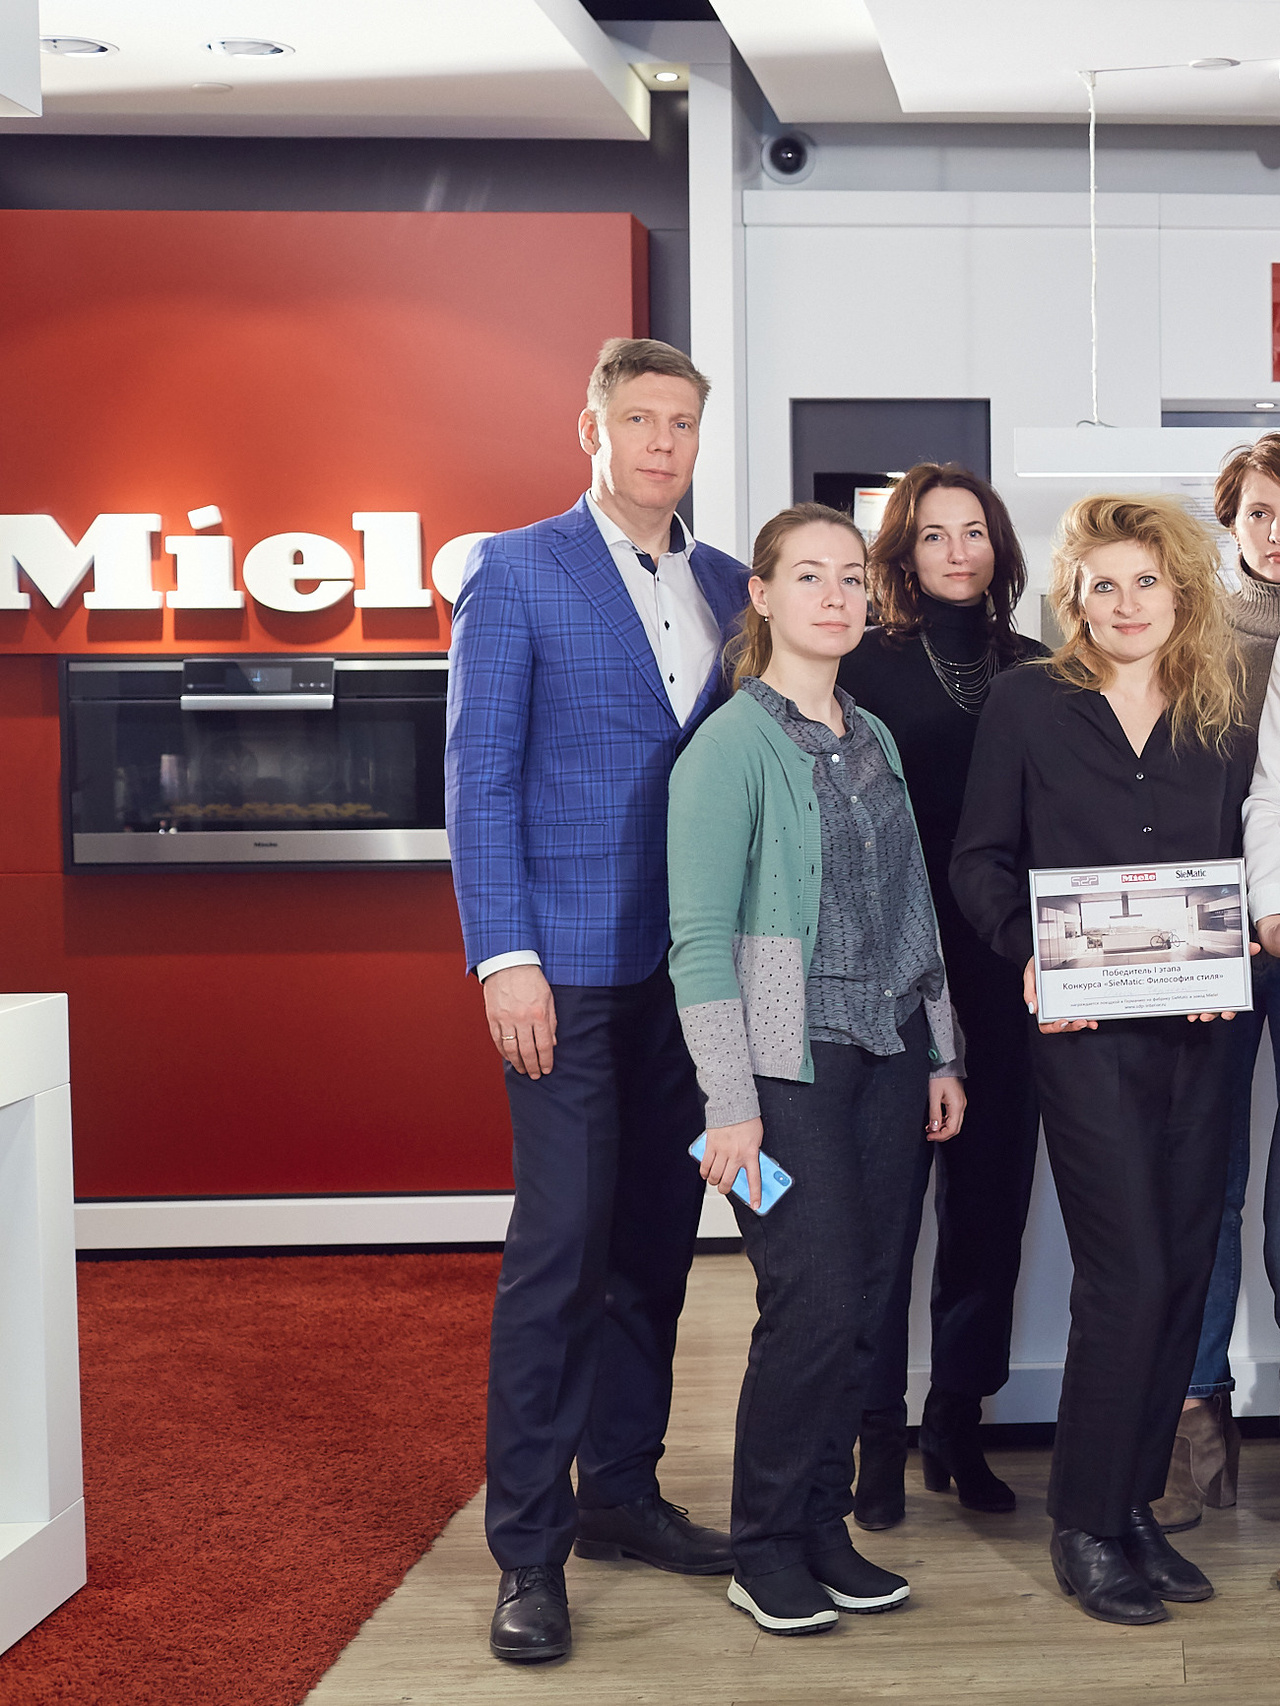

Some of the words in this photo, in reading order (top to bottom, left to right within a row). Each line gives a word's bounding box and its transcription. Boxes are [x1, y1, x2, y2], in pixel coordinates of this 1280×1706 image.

[1122, 873, 1156, 883] Miele
[1175, 868, 1207, 879] SieMatic
[1102, 968, 1152, 977] Победитель
[1062, 981, 1102, 991] Конкурса
[1146, 975, 1195, 984] Философия
[1196, 973, 1224, 981] стиля»
